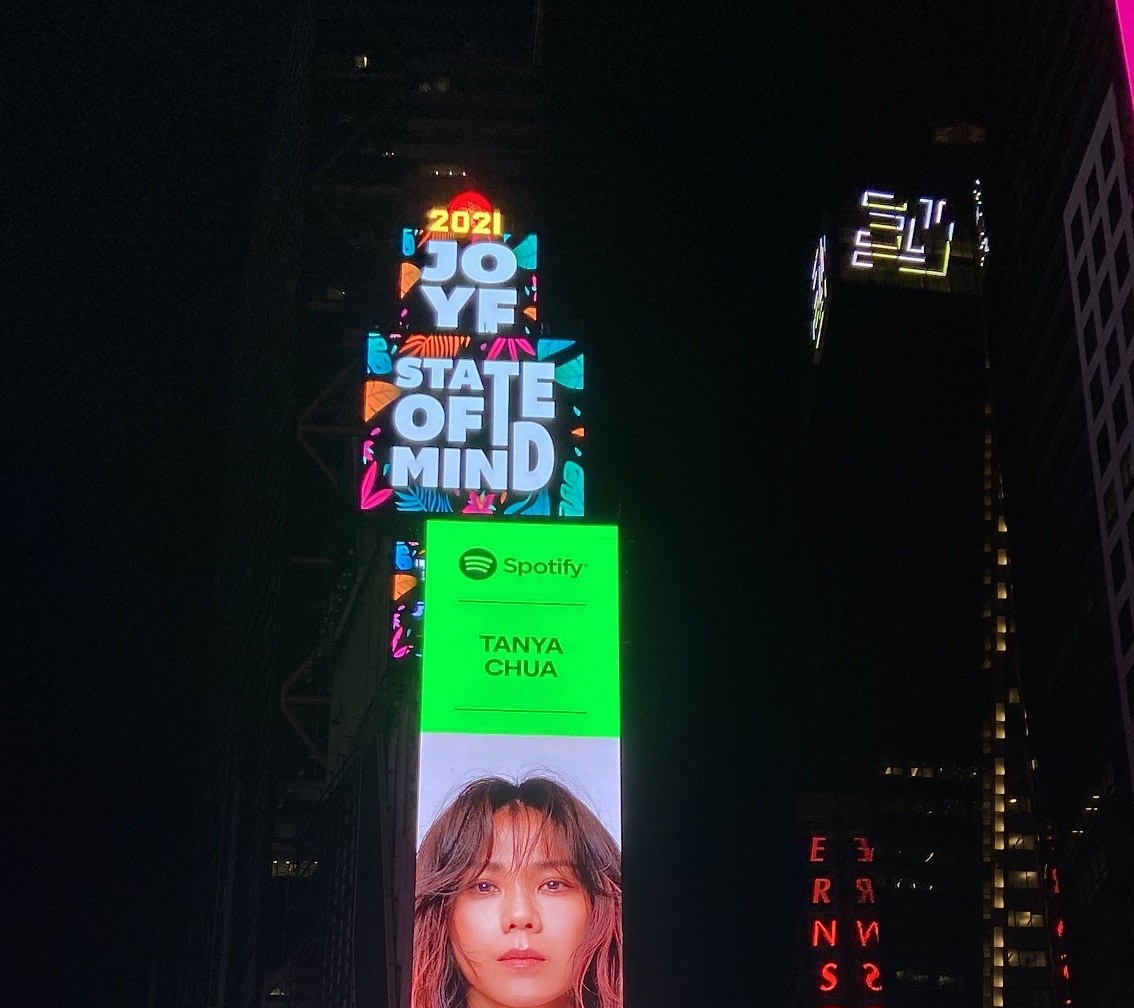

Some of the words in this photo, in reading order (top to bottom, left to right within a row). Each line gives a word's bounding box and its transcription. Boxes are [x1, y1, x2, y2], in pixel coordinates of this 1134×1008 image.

[427, 208, 502, 235] 2021
[420, 240, 519, 284] JO
[393, 396, 483, 442] OF
[395, 357, 556, 446] STATE
[389, 420, 556, 492] MIND
[503, 557, 588, 579] Spotify
[478, 634, 564, 655] TANYA
[484, 658, 558, 678] CHUA
